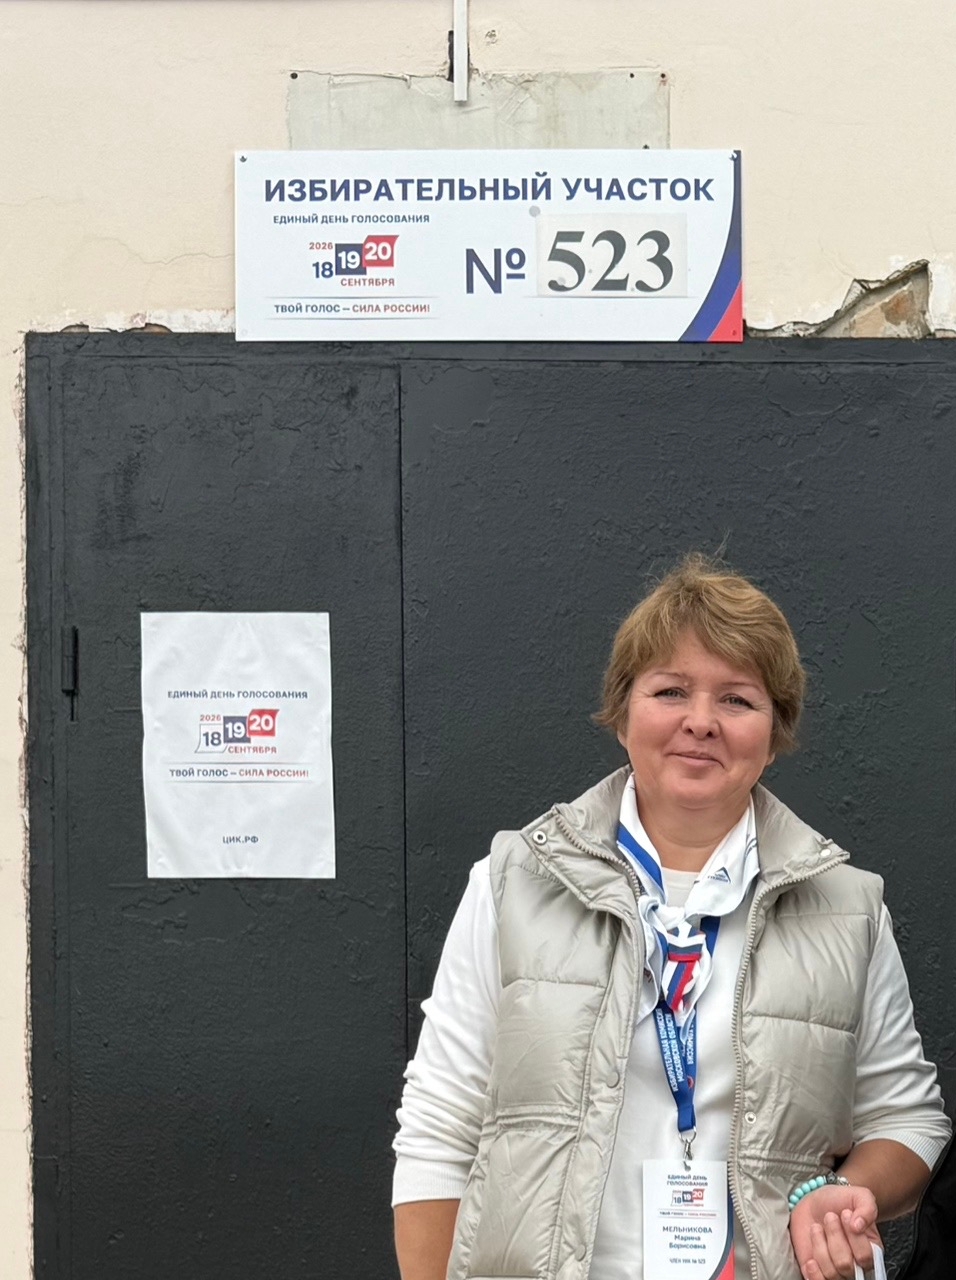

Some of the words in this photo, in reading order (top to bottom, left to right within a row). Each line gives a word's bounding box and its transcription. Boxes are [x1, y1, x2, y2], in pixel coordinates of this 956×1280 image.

[264, 171, 552, 202] ИЗБИРАТЕЛЬНЫЙ
[562, 177, 715, 202] УЧАСТОК
[273, 213, 319, 224] ЕДИНЫЙ
[321, 214, 349, 225] ДЕНЬ
[351, 214, 430, 224] ГОЛОСОВАНИЯ
[308, 242, 333, 251] 2026
[312, 261, 334, 279] 18
[337, 250, 360, 269] 19
[364, 241, 392, 261] 20
[465, 247, 526, 295] №
[547, 229, 674, 293] 523
[340, 277, 395, 287] СЕНТЯБРЯ
[274, 303, 303, 313] ТВОЙ
[305, 304, 341, 313] ГОЛОС
[352, 304, 382, 313] СИЛА
[383, 304, 430, 313] РОССИИ!
[167, 689, 209, 699] ЕДИНЫЙ
[210, 690, 236, 699] ДЕНЬ
[237, 690, 308, 699] ГОЛОСОВАНИЯ
[200, 714, 222, 722] 2026
[202, 731, 222, 747] 18
[225, 722, 246, 739] 19
[249, 714, 274, 731] 20
[227, 746, 277, 754] СЕНТЯБРЯ
[169, 767, 195, 777] ТВОЙ
[197, 768, 229, 777] ГОЛОС
[239, 769, 265, 777] СИЛА
[266, 769, 309, 778] РОССИИ!
[222, 835, 259, 845] ЦИК.РФ
[692, 1190, 703, 1200] 20
[662, 1225, 713, 1234] МЕЛЬНИКОВА
[674, 1234, 702, 1242] Марина
[669, 1242, 707, 1250] Борисовна
